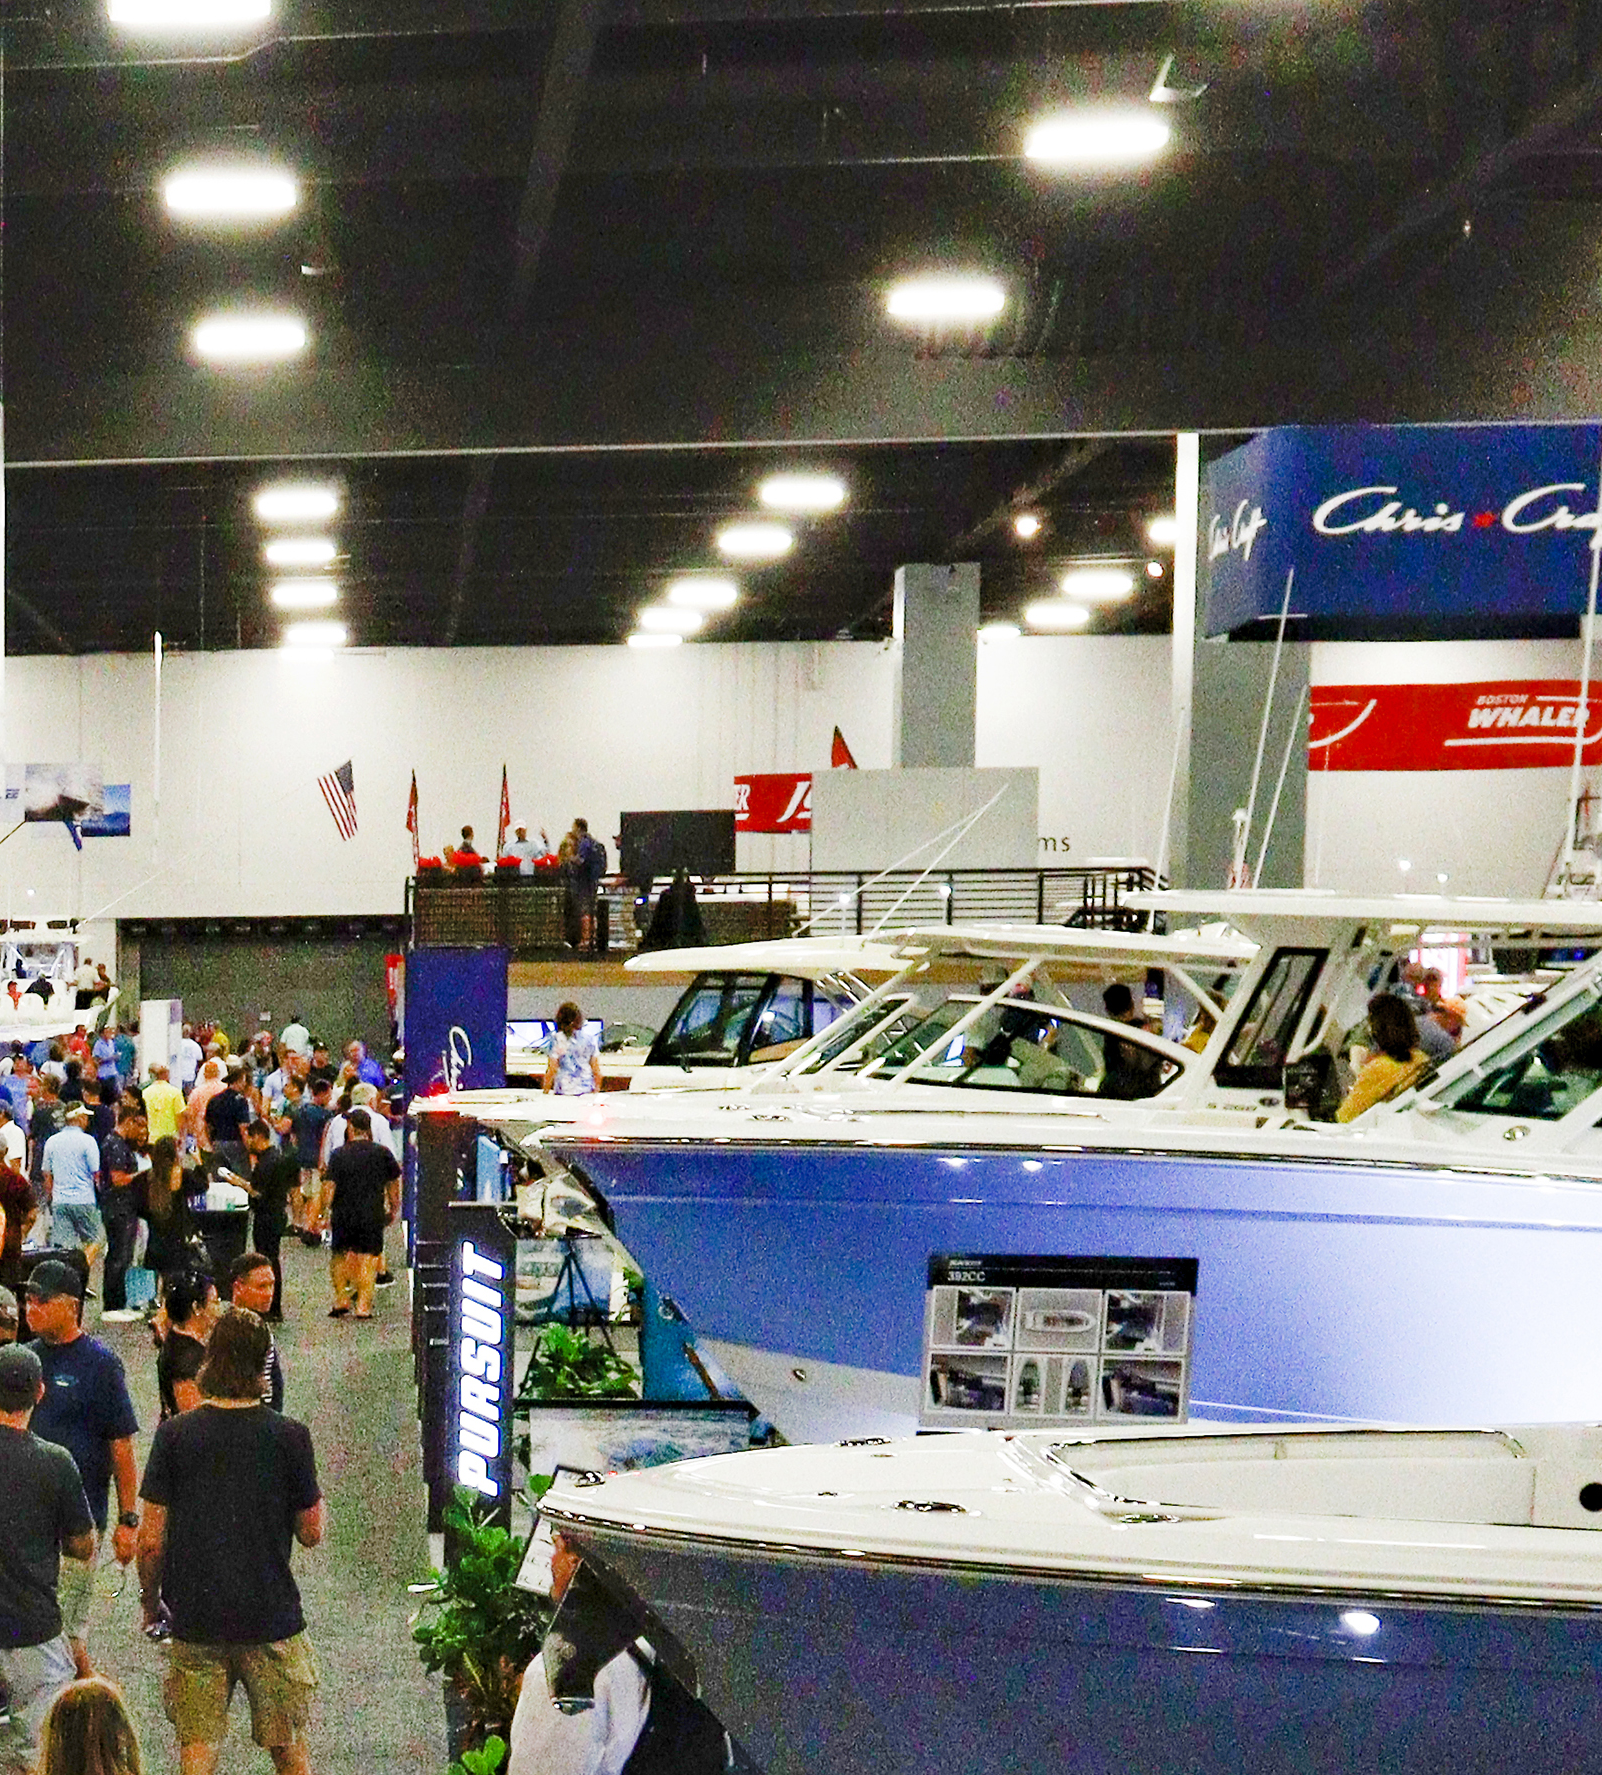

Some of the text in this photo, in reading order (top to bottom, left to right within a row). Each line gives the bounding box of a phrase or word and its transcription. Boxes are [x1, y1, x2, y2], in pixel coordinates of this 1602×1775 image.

[1312, 486, 1464, 535] Chris
[1476, 694, 1529, 705] BOSTON
[457, 1240, 504, 1498] PURSUIT
